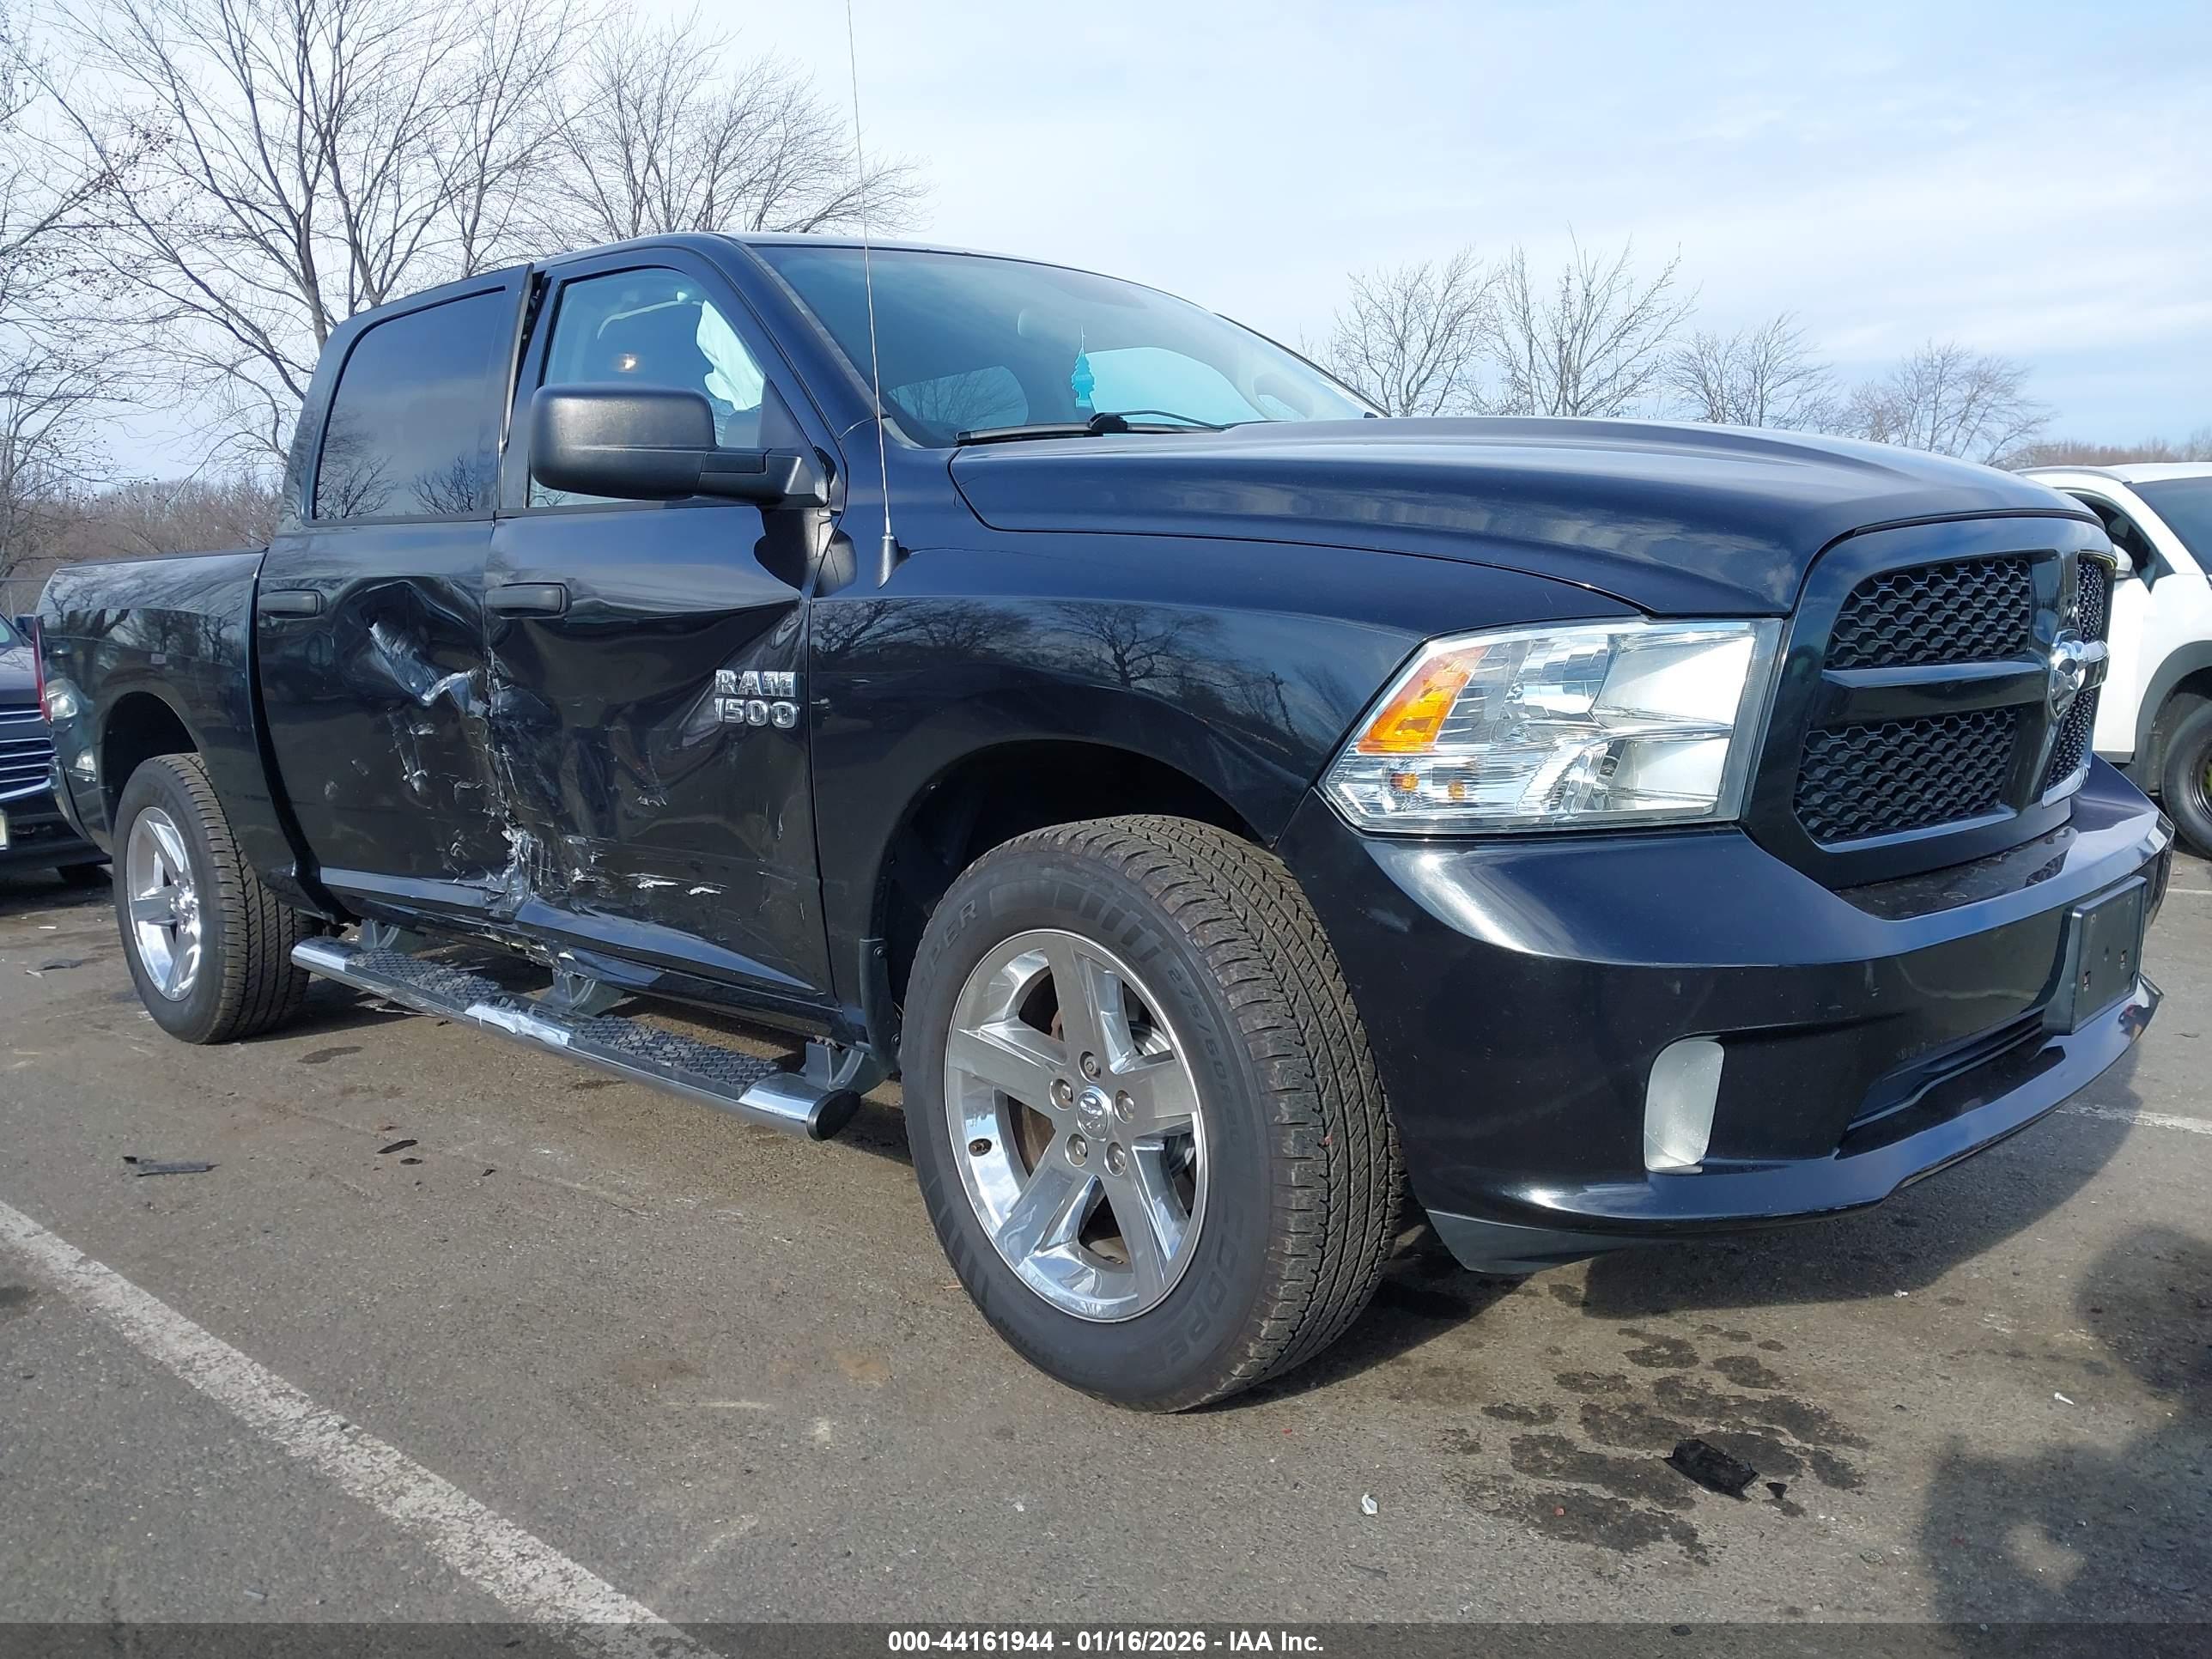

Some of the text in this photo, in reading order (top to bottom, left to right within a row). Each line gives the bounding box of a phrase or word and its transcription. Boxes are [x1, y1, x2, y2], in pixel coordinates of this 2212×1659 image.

[714, 669, 797, 698] RAM
[714, 697, 798, 729] 1500
[1158, 1194, 1244, 1364] COOPE
